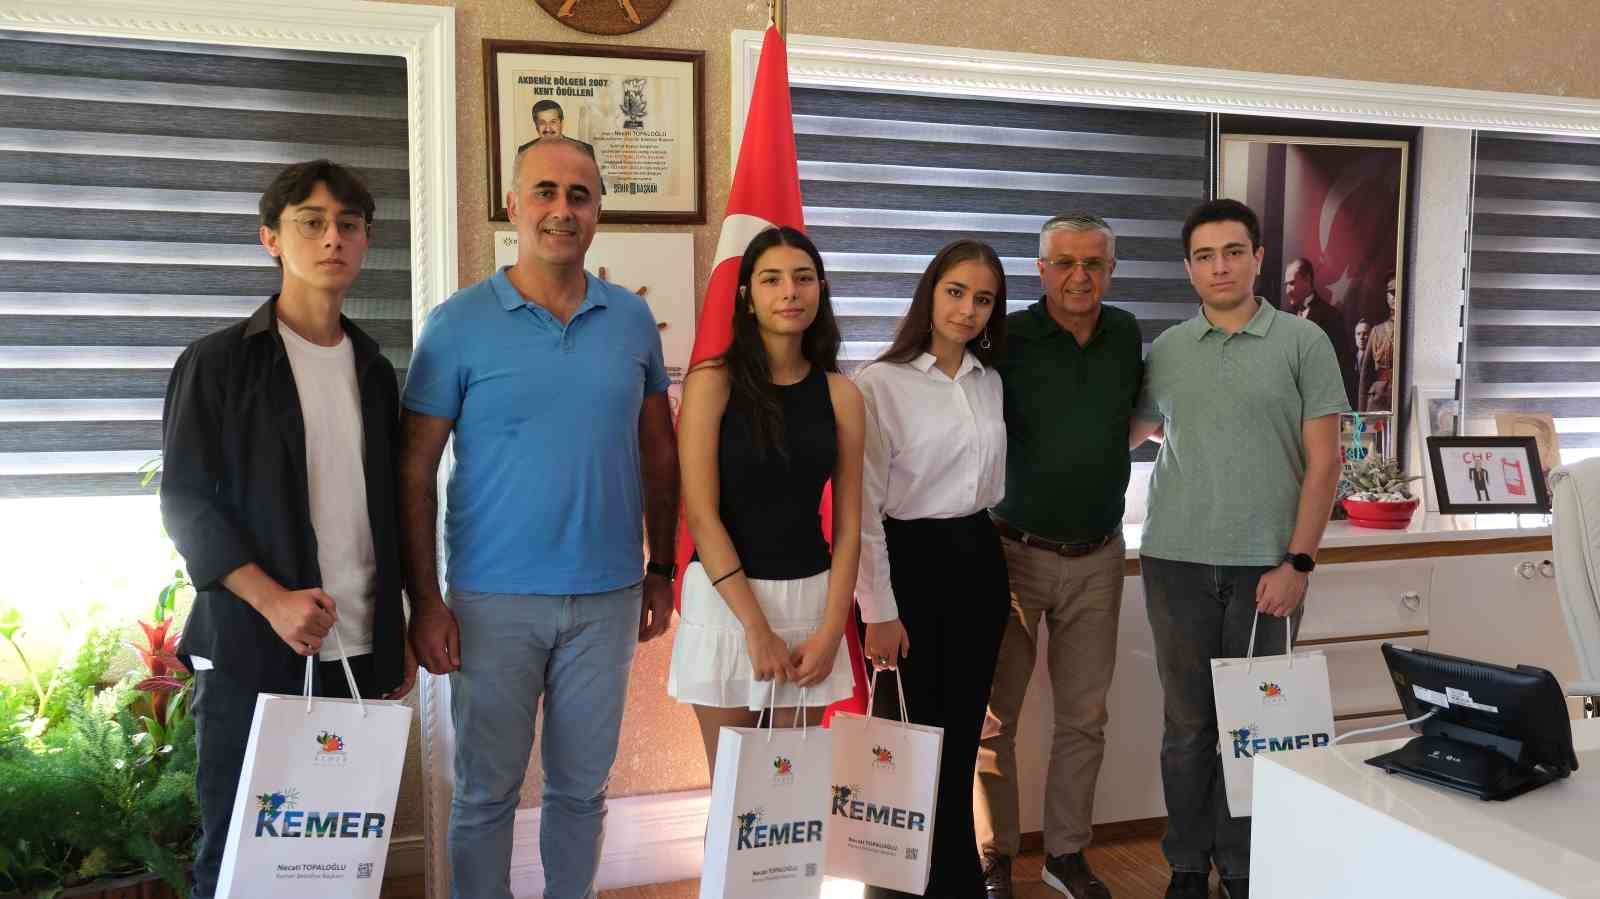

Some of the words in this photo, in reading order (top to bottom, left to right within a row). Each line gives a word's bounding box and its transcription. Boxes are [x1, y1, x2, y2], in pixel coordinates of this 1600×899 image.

[518, 75, 552, 85] AKDENİZ
[554, 77, 587, 86] BÖLGESİ
[589, 79, 608, 87] 2007
[534, 87, 554, 96] KENT
[556, 87, 594, 97] ÖDÜLLERİ
[1463, 451, 1493, 464] CHP
[1233, 733, 1329, 758] KEMER
[831, 796, 926, 831] KEMER
[255, 810, 385, 838] KEMER
[737, 820, 823, 850] KEMER
[277, 863, 301, 871] Necati
[302, 862, 346, 871] TOPALOĞLU
